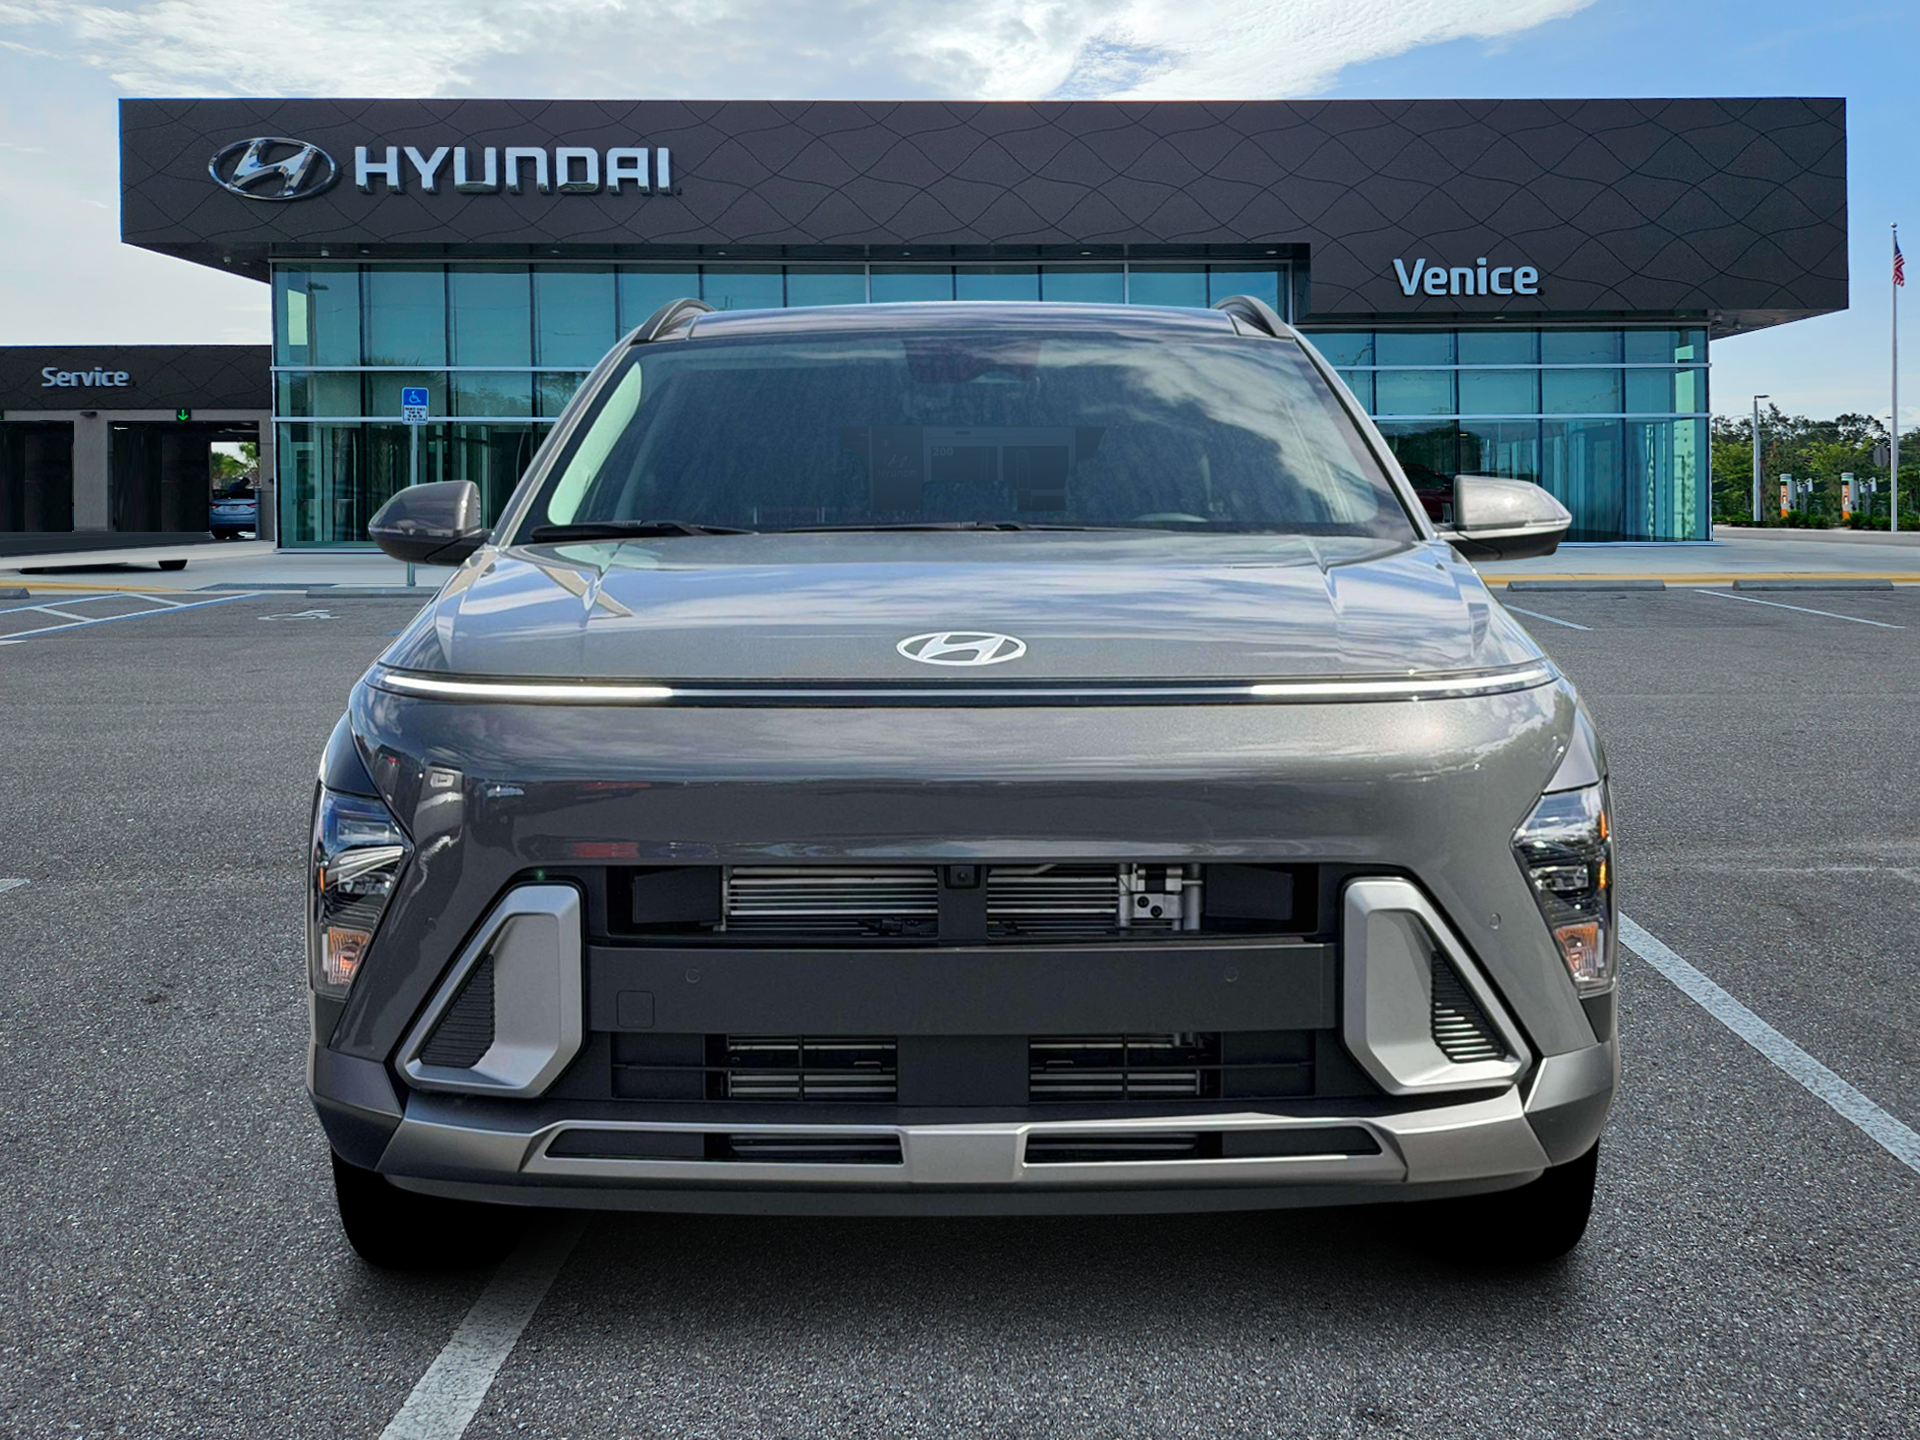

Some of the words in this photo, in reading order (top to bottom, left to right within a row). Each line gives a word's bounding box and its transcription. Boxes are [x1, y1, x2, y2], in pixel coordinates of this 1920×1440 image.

[354, 145, 672, 195] HYUNDAI
[1392, 256, 1540, 296] Venice
[41, 366, 130, 387] Service
[932, 446, 954, 457] 200
